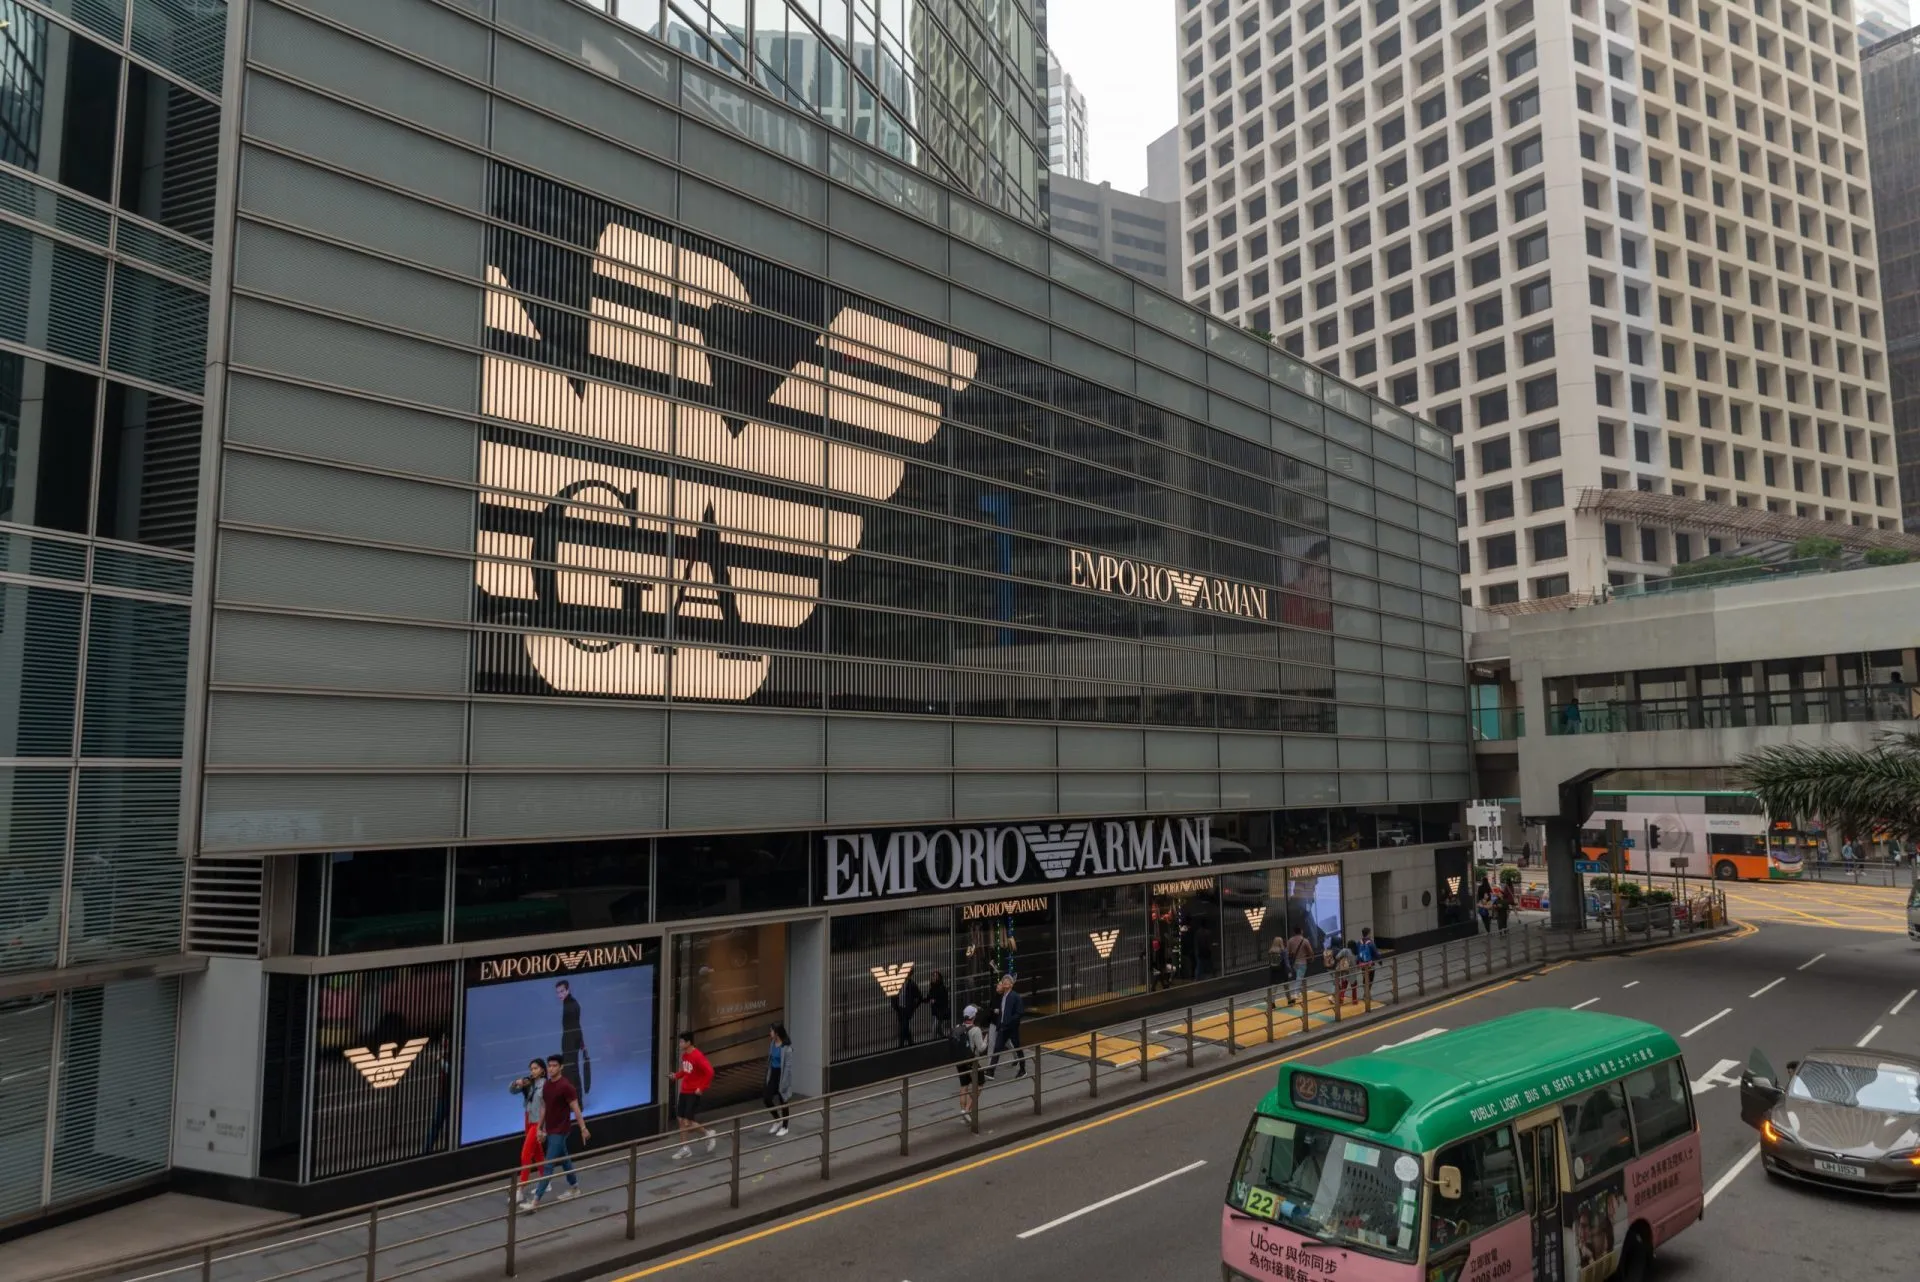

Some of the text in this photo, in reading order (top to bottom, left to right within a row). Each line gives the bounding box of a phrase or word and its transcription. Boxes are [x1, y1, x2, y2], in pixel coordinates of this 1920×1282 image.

[1070, 548, 1269, 620] EMPORIO ARMANI
[823, 816, 1213, 901] EMPORIO ARMANI
[963, 896, 1048, 920] EMPORIO ARMANI
[480, 943, 643, 981] EMPORIO ARMANI
[1469, 1075, 1576, 1124] PUBLIC LIGHT BUS 16 SEATS
[1249, 1192, 1273, 1215] 22
[1249, 1251, 1336, 1282] 為你接載每一
[1250, 1230, 1338, 1275] Uber 與你同步
[1493, 1259, 1512, 1279] 4009
